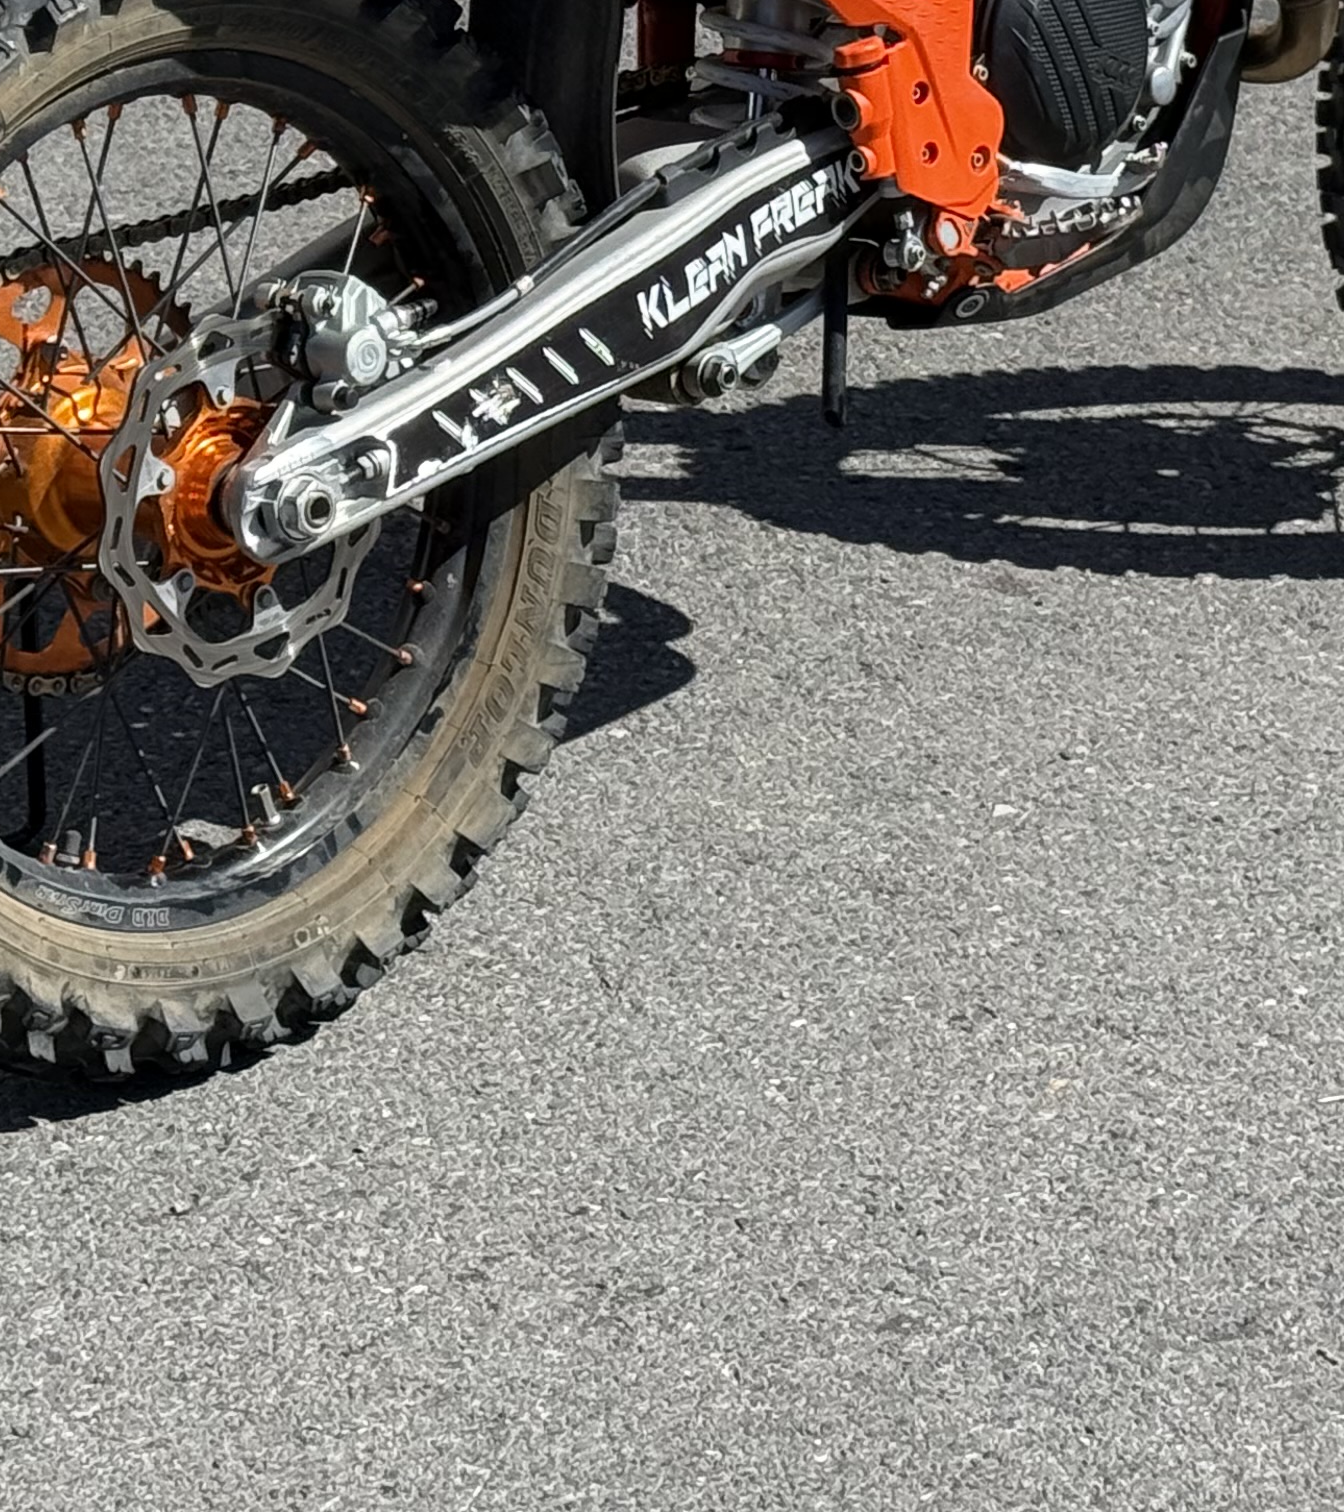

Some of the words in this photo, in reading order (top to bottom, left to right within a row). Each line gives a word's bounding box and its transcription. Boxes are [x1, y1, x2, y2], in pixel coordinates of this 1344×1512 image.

[637, 223, 748, 339] KLEAN
[750, 159, 860, 257] FREAK
[461, 486, 564, 770] DUNLOP
